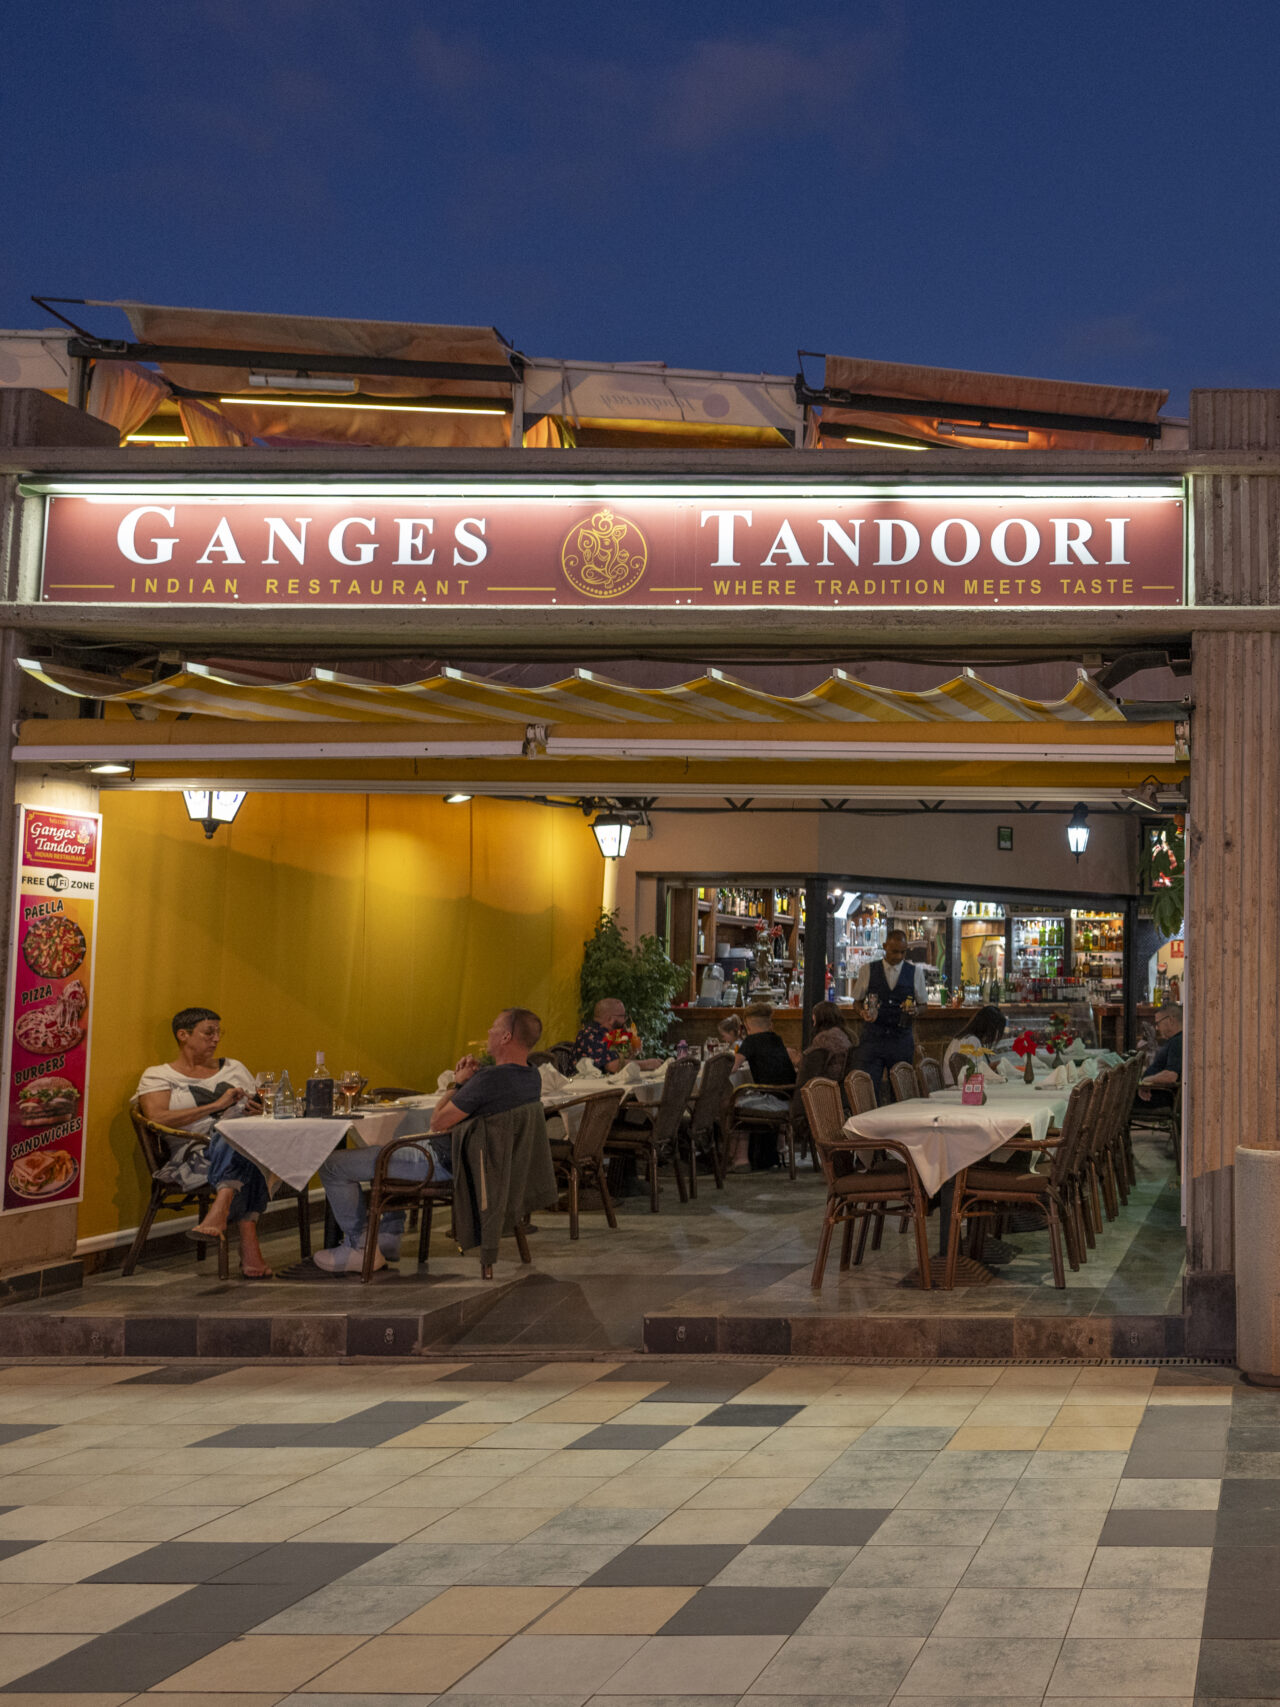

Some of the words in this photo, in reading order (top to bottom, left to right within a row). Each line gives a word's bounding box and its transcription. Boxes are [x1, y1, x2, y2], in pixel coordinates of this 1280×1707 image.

[116, 505, 489, 566] GANGES
[700, 509, 1131, 567] TANDOORI
[130, 578, 239, 595] INDIAN
[265, 578, 471, 596] RESTAURANT
[713, 579, 797, 596] WHERE
[815, 578, 946, 596] TRADITION
[963, 578, 1043, 595] MEETS
[1060, 578, 1135, 595] TASTE
[30, 822, 77, 841] Ganges
[34, 837, 87, 856] Tandoori
[54, 853, 86, 863] RESTAURANT
[22, 875, 45, 886] FREE
[71, 880, 95, 890] ZONE
[24, 900, 64, 921] PAELLA
[22, 984, 53, 1006] PIZZA
[14, 1054, 66, 1085] BURGERS
[10, 1117, 82, 1160] SANDWICHES
